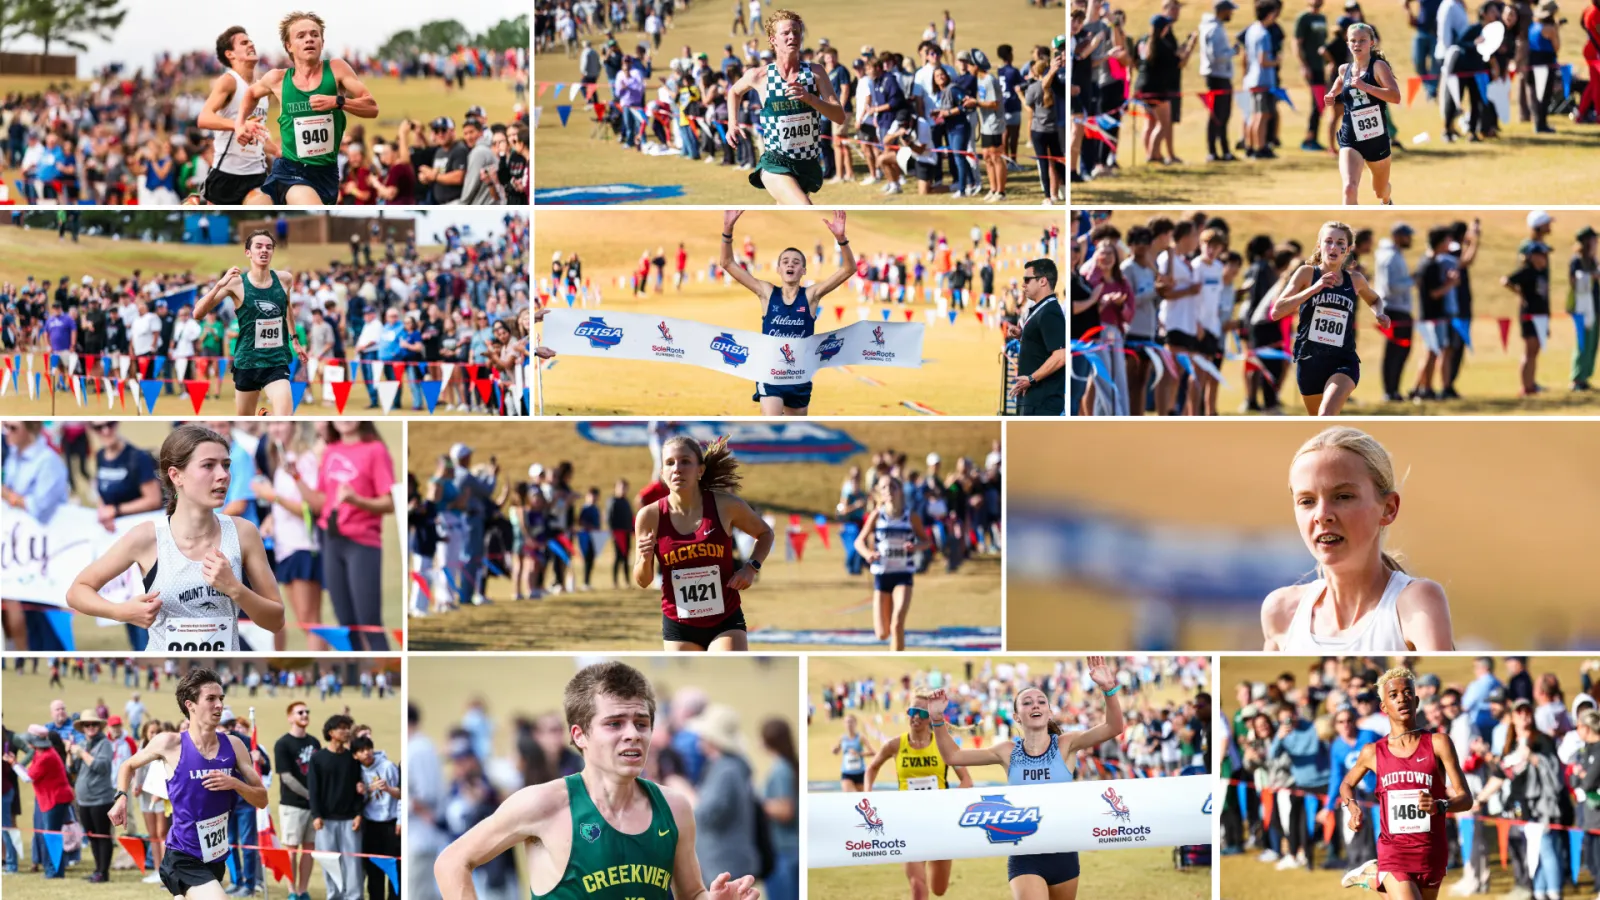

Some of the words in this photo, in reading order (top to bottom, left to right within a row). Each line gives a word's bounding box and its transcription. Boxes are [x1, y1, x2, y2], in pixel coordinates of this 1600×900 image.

[1357, 116, 1379, 131] 933
[302, 128, 329, 145] 940
[782, 123, 811, 140] 2449
[770, 314, 805, 326] Atlanta
[1314, 318, 1344, 336] 1380
[260, 327, 279, 339] 499
[575, 326, 622, 338] GHSA
[652, 345, 685, 355] SoleRoots
[711, 341, 749, 357] GHSA
[862, 350, 895, 358] SoleRoots
[770, 368, 806, 376] SoleRoots
[663, 543, 725, 566] JACKSON
[178, 586, 204, 604] MOUNT
[679, 582, 717, 603] 1421
[902, 755, 938, 768] EVANS
[1023, 768, 1050, 781] POPE
[1380, 770, 1433, 788] MIDTOWN
[960, 808, 1039, 826] GHSA
[204, 826, 226, 849] 1231
[1092, 825, 1151, 837] SoleRoots
[845, 838, 906, 851] SoleRoots
[1098, 836, 1132, 844] RUNNING
[852, 850, 887, 858] RUNNING
[582, 863, 671, 894] CREEKVIEW
